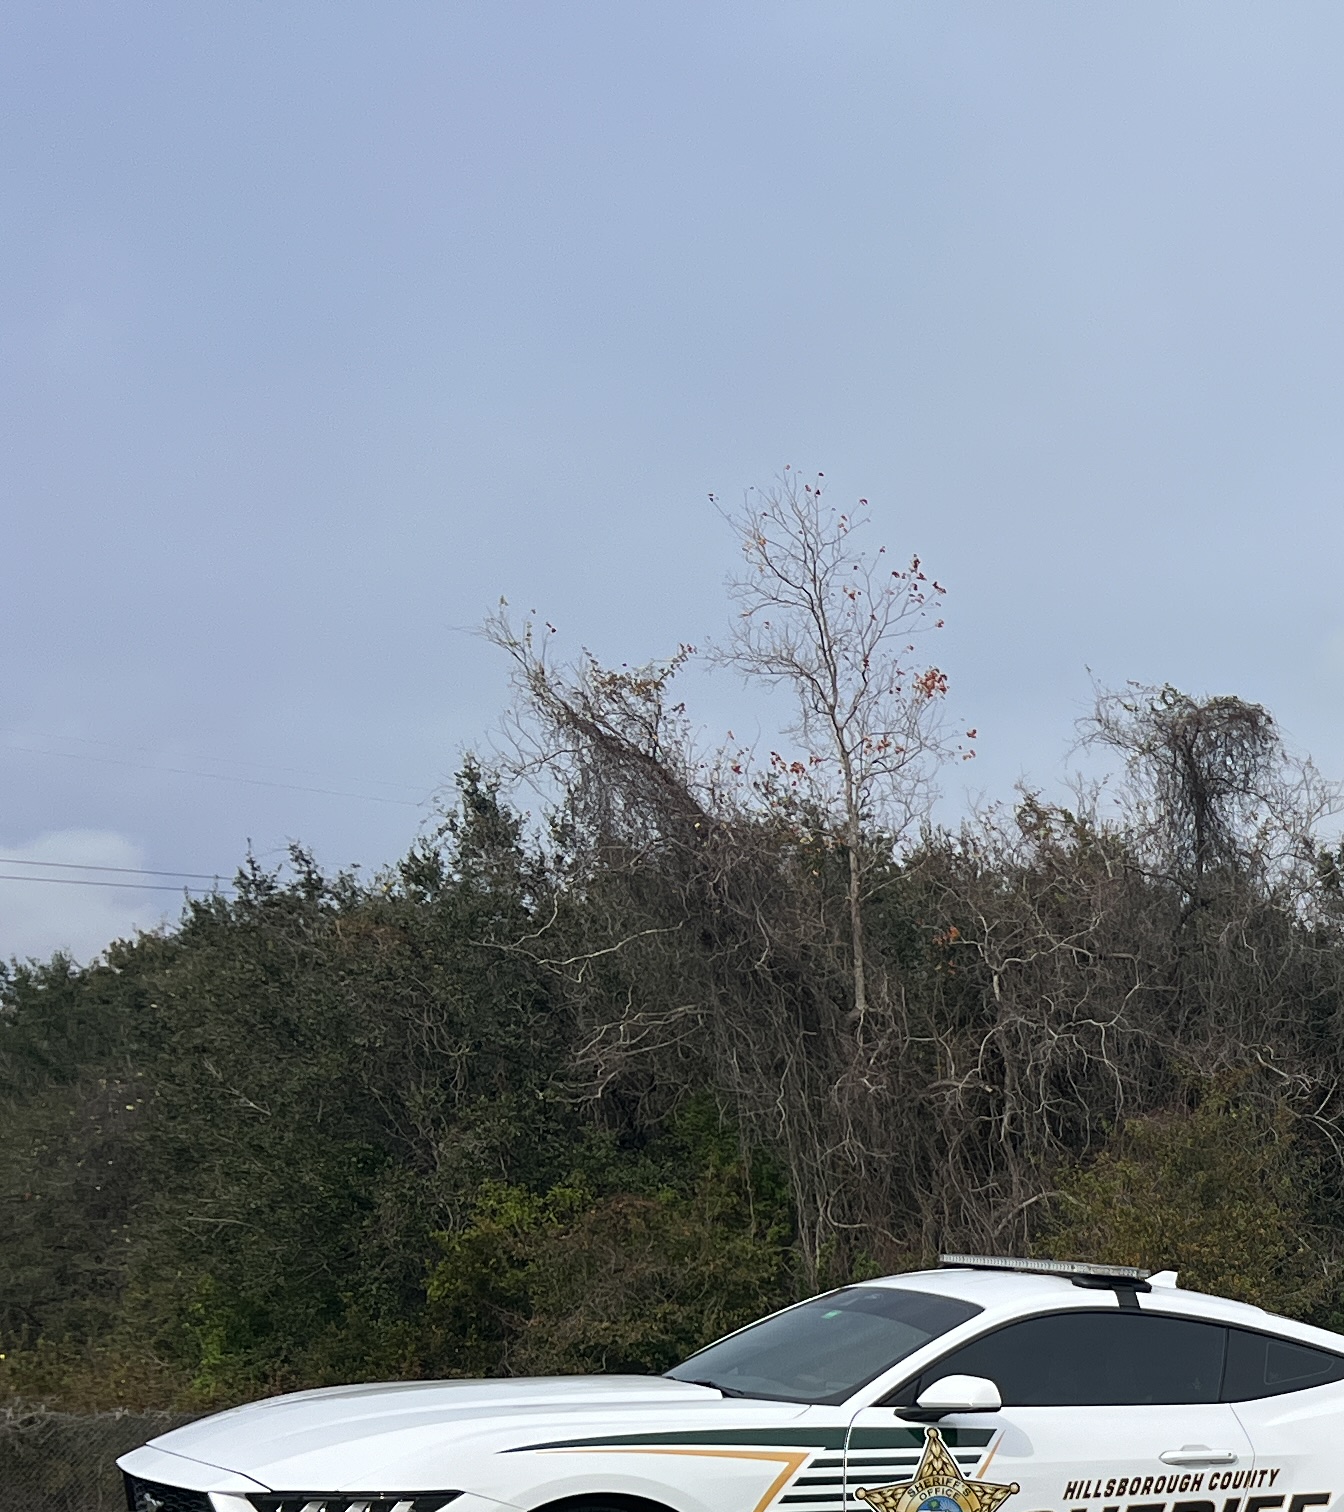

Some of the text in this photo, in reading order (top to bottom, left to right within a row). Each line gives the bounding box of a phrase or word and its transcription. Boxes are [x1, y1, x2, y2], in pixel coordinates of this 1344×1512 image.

[907, 1477, 971, 1498] SHERIFF'S
[919, 1486, 960, 1501] OFFICE
[1063, 1468, 1281, 1500] HILLSBOROUGH COUNTY
